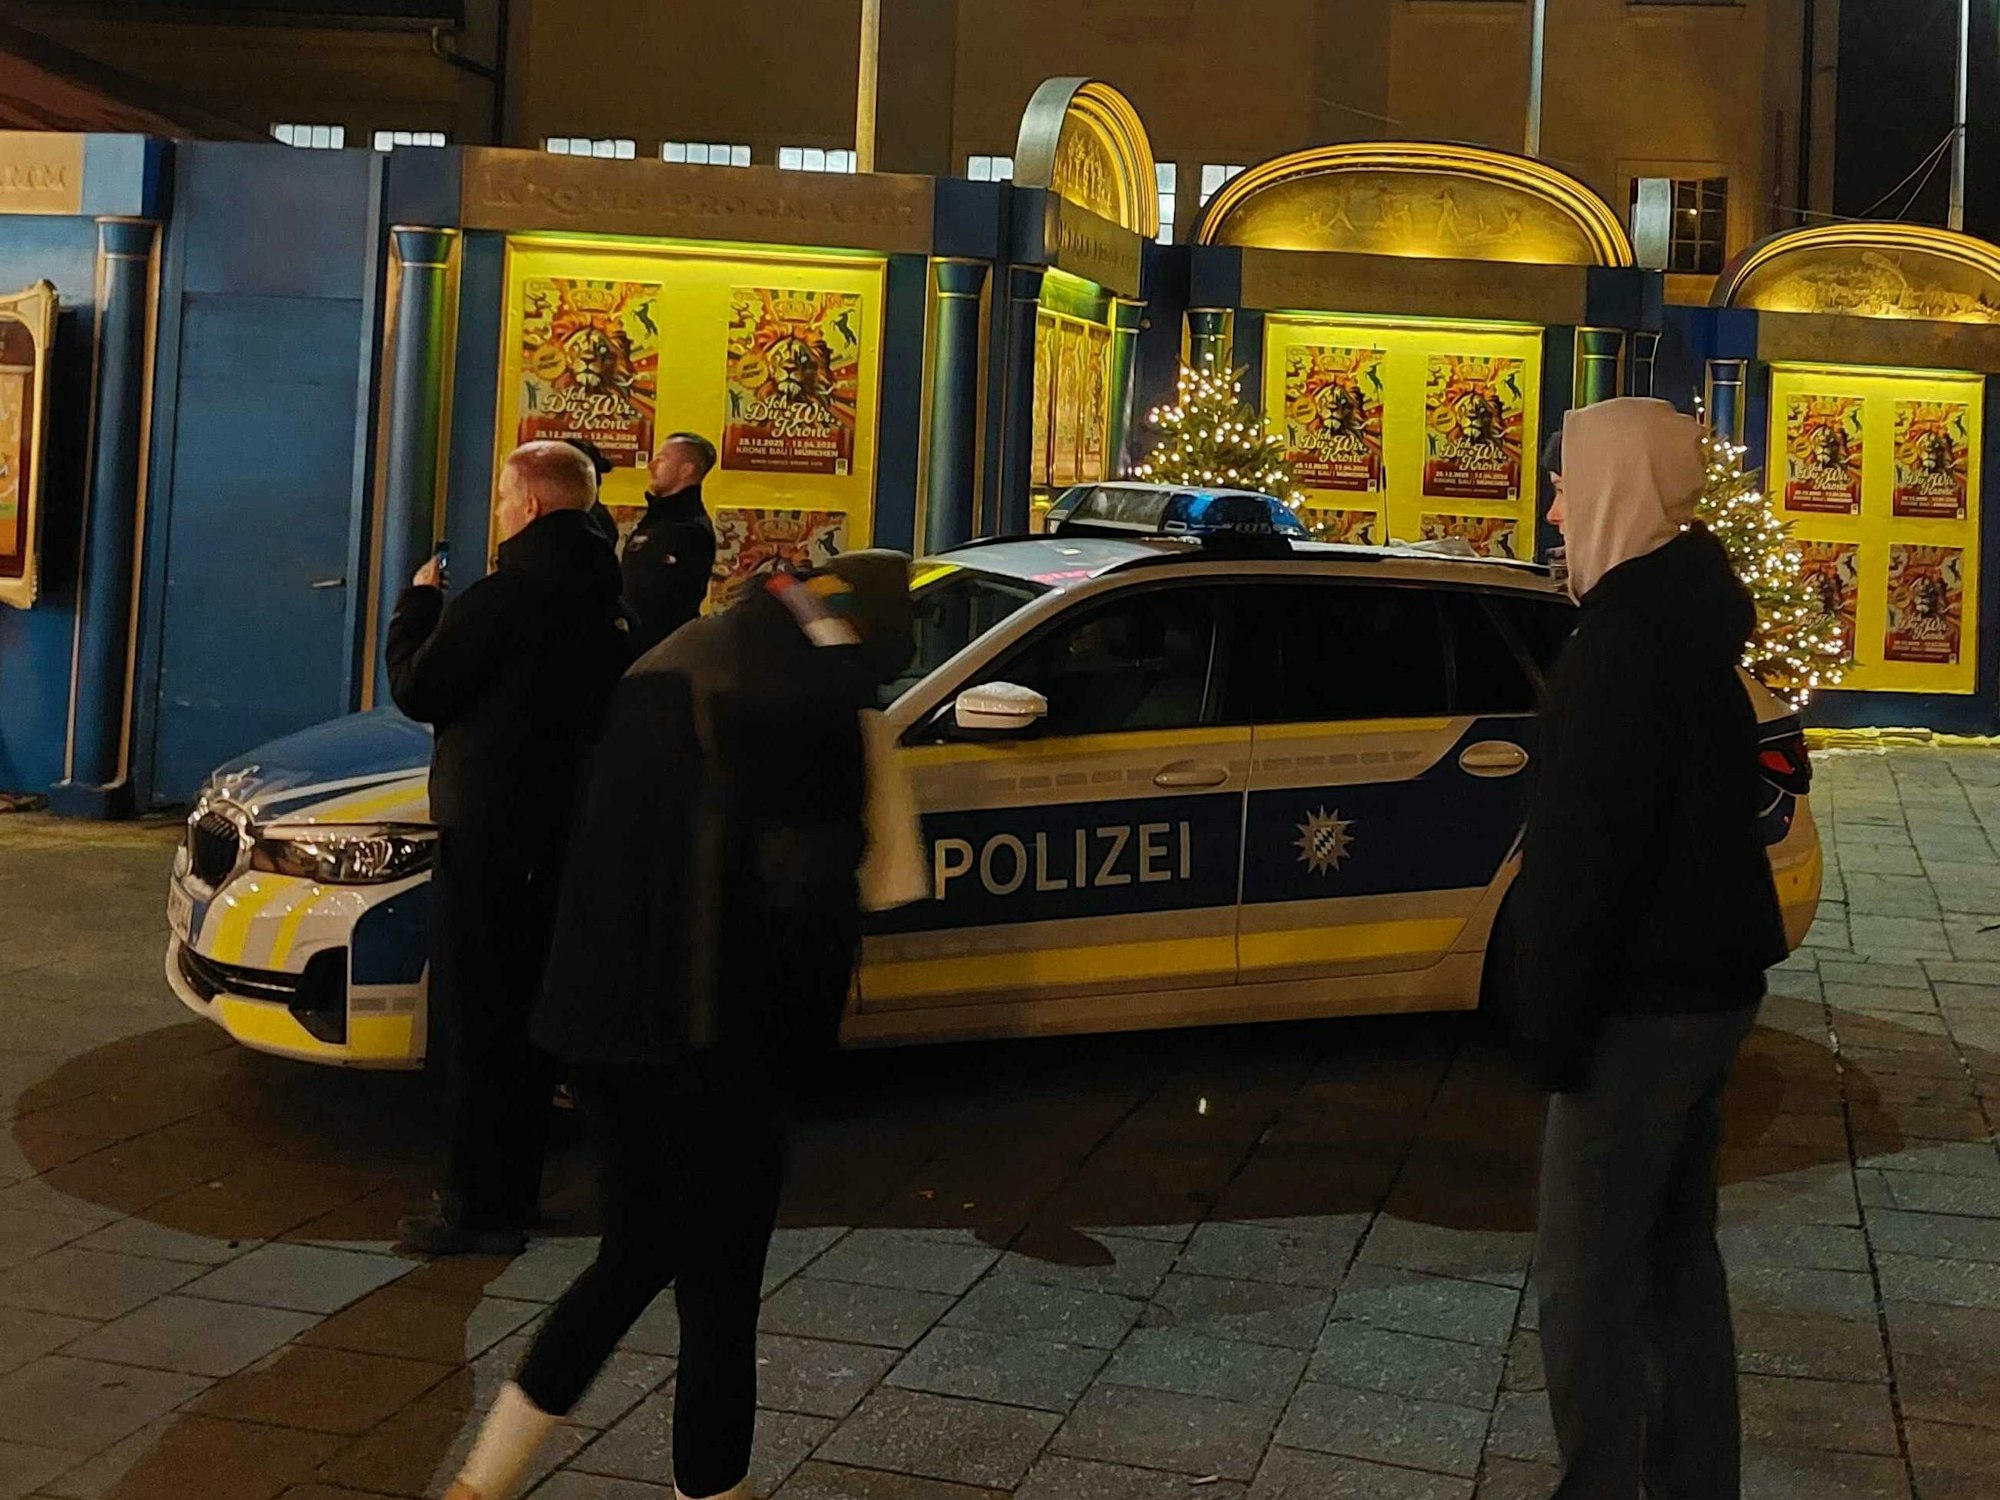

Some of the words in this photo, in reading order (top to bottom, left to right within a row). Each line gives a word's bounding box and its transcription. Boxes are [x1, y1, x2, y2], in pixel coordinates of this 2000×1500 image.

[569, 410, 631, 430] Krone
[771, 418, 831, 438] Krone
[935, 821, 1191, 900] POLIZEI
